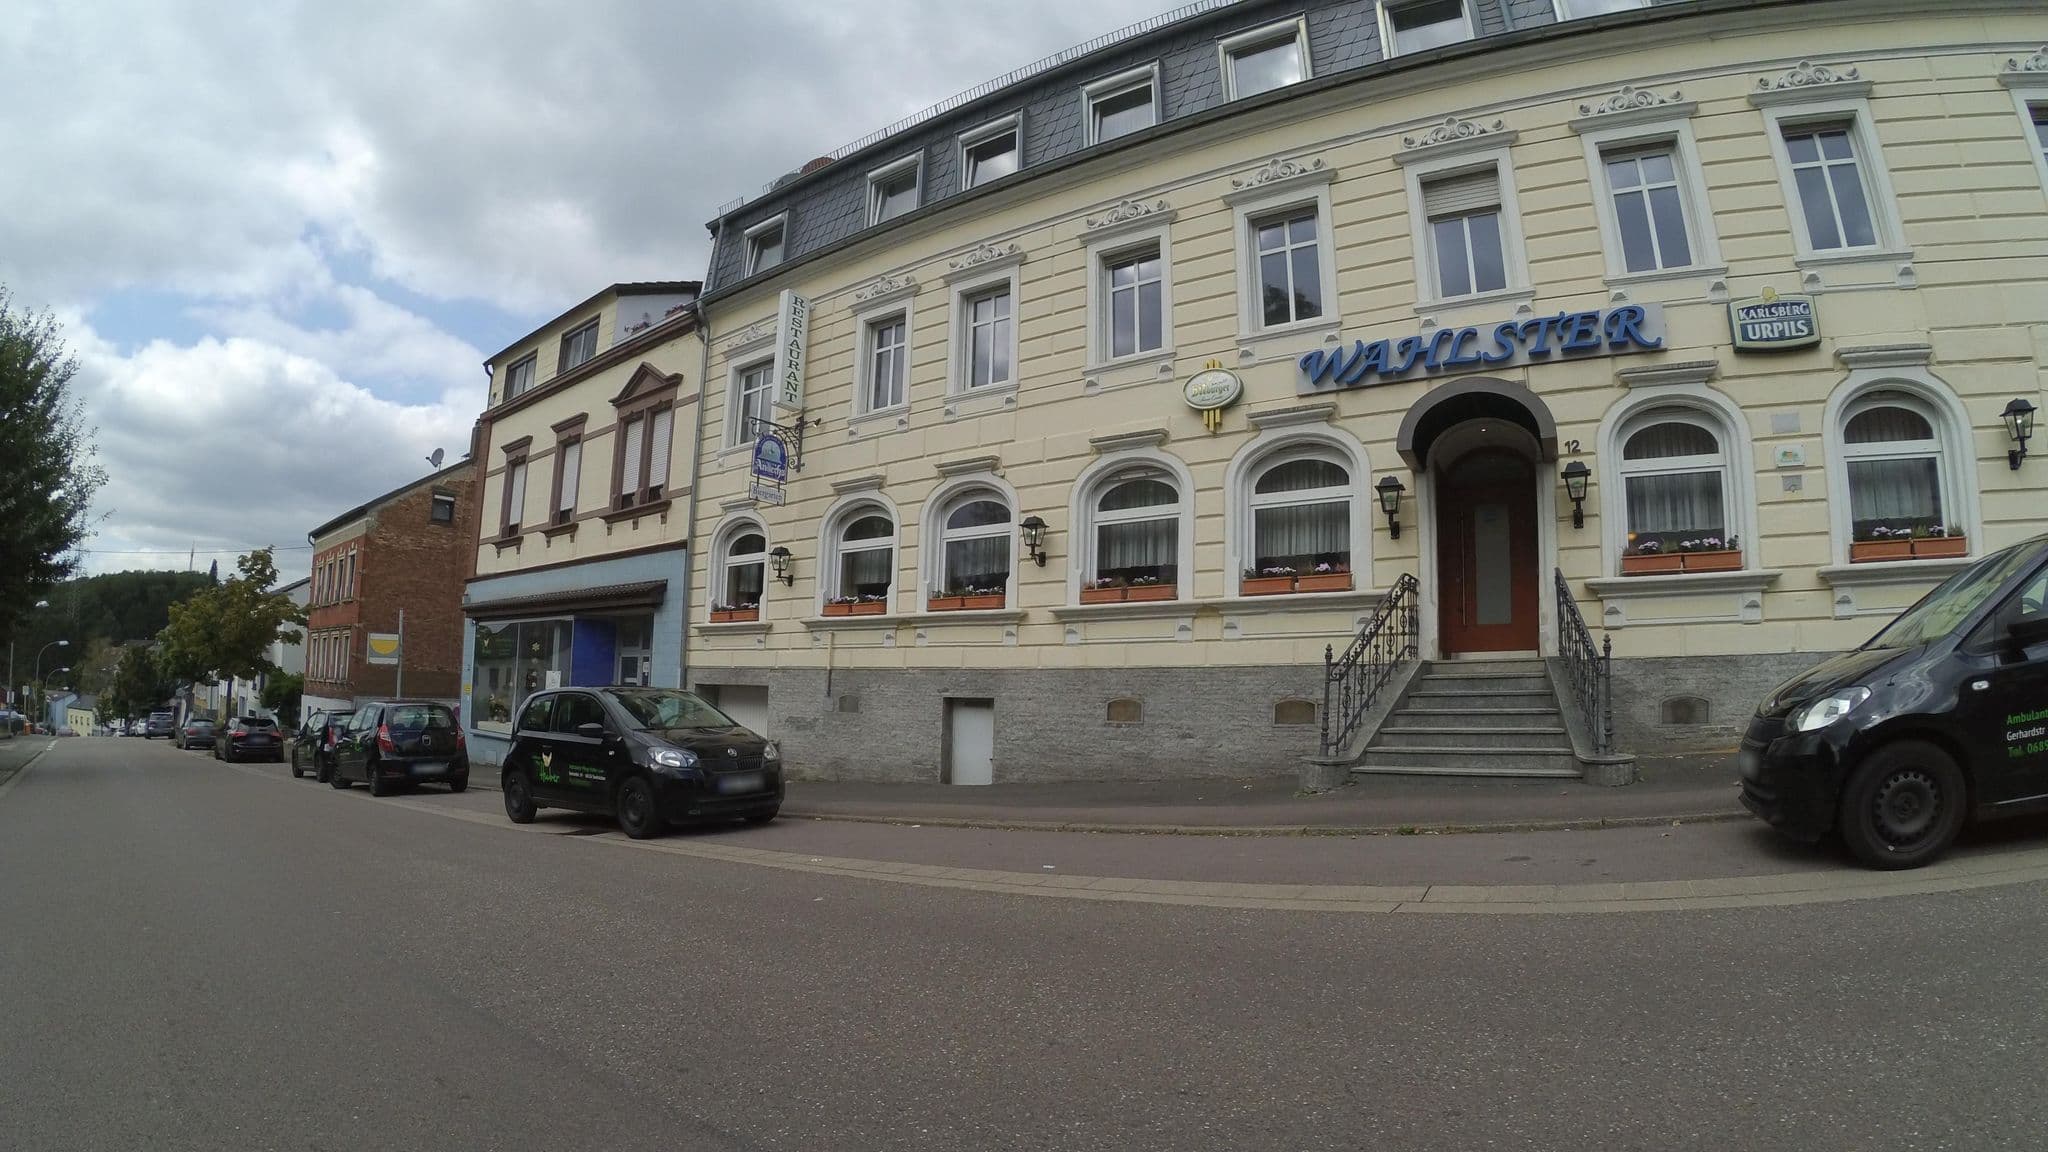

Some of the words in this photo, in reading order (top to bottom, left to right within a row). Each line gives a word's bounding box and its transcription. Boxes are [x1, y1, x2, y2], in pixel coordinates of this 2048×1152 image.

[1739, 304, 1809, 320] KARLSBERG
[1747, 320, 1809, 340] URPILS
[785, 296, 805, 403] RESTAURANT
[1299, 305, 1662, 385] WAHLSTER
[1565, 440, 1581, 455] 12
